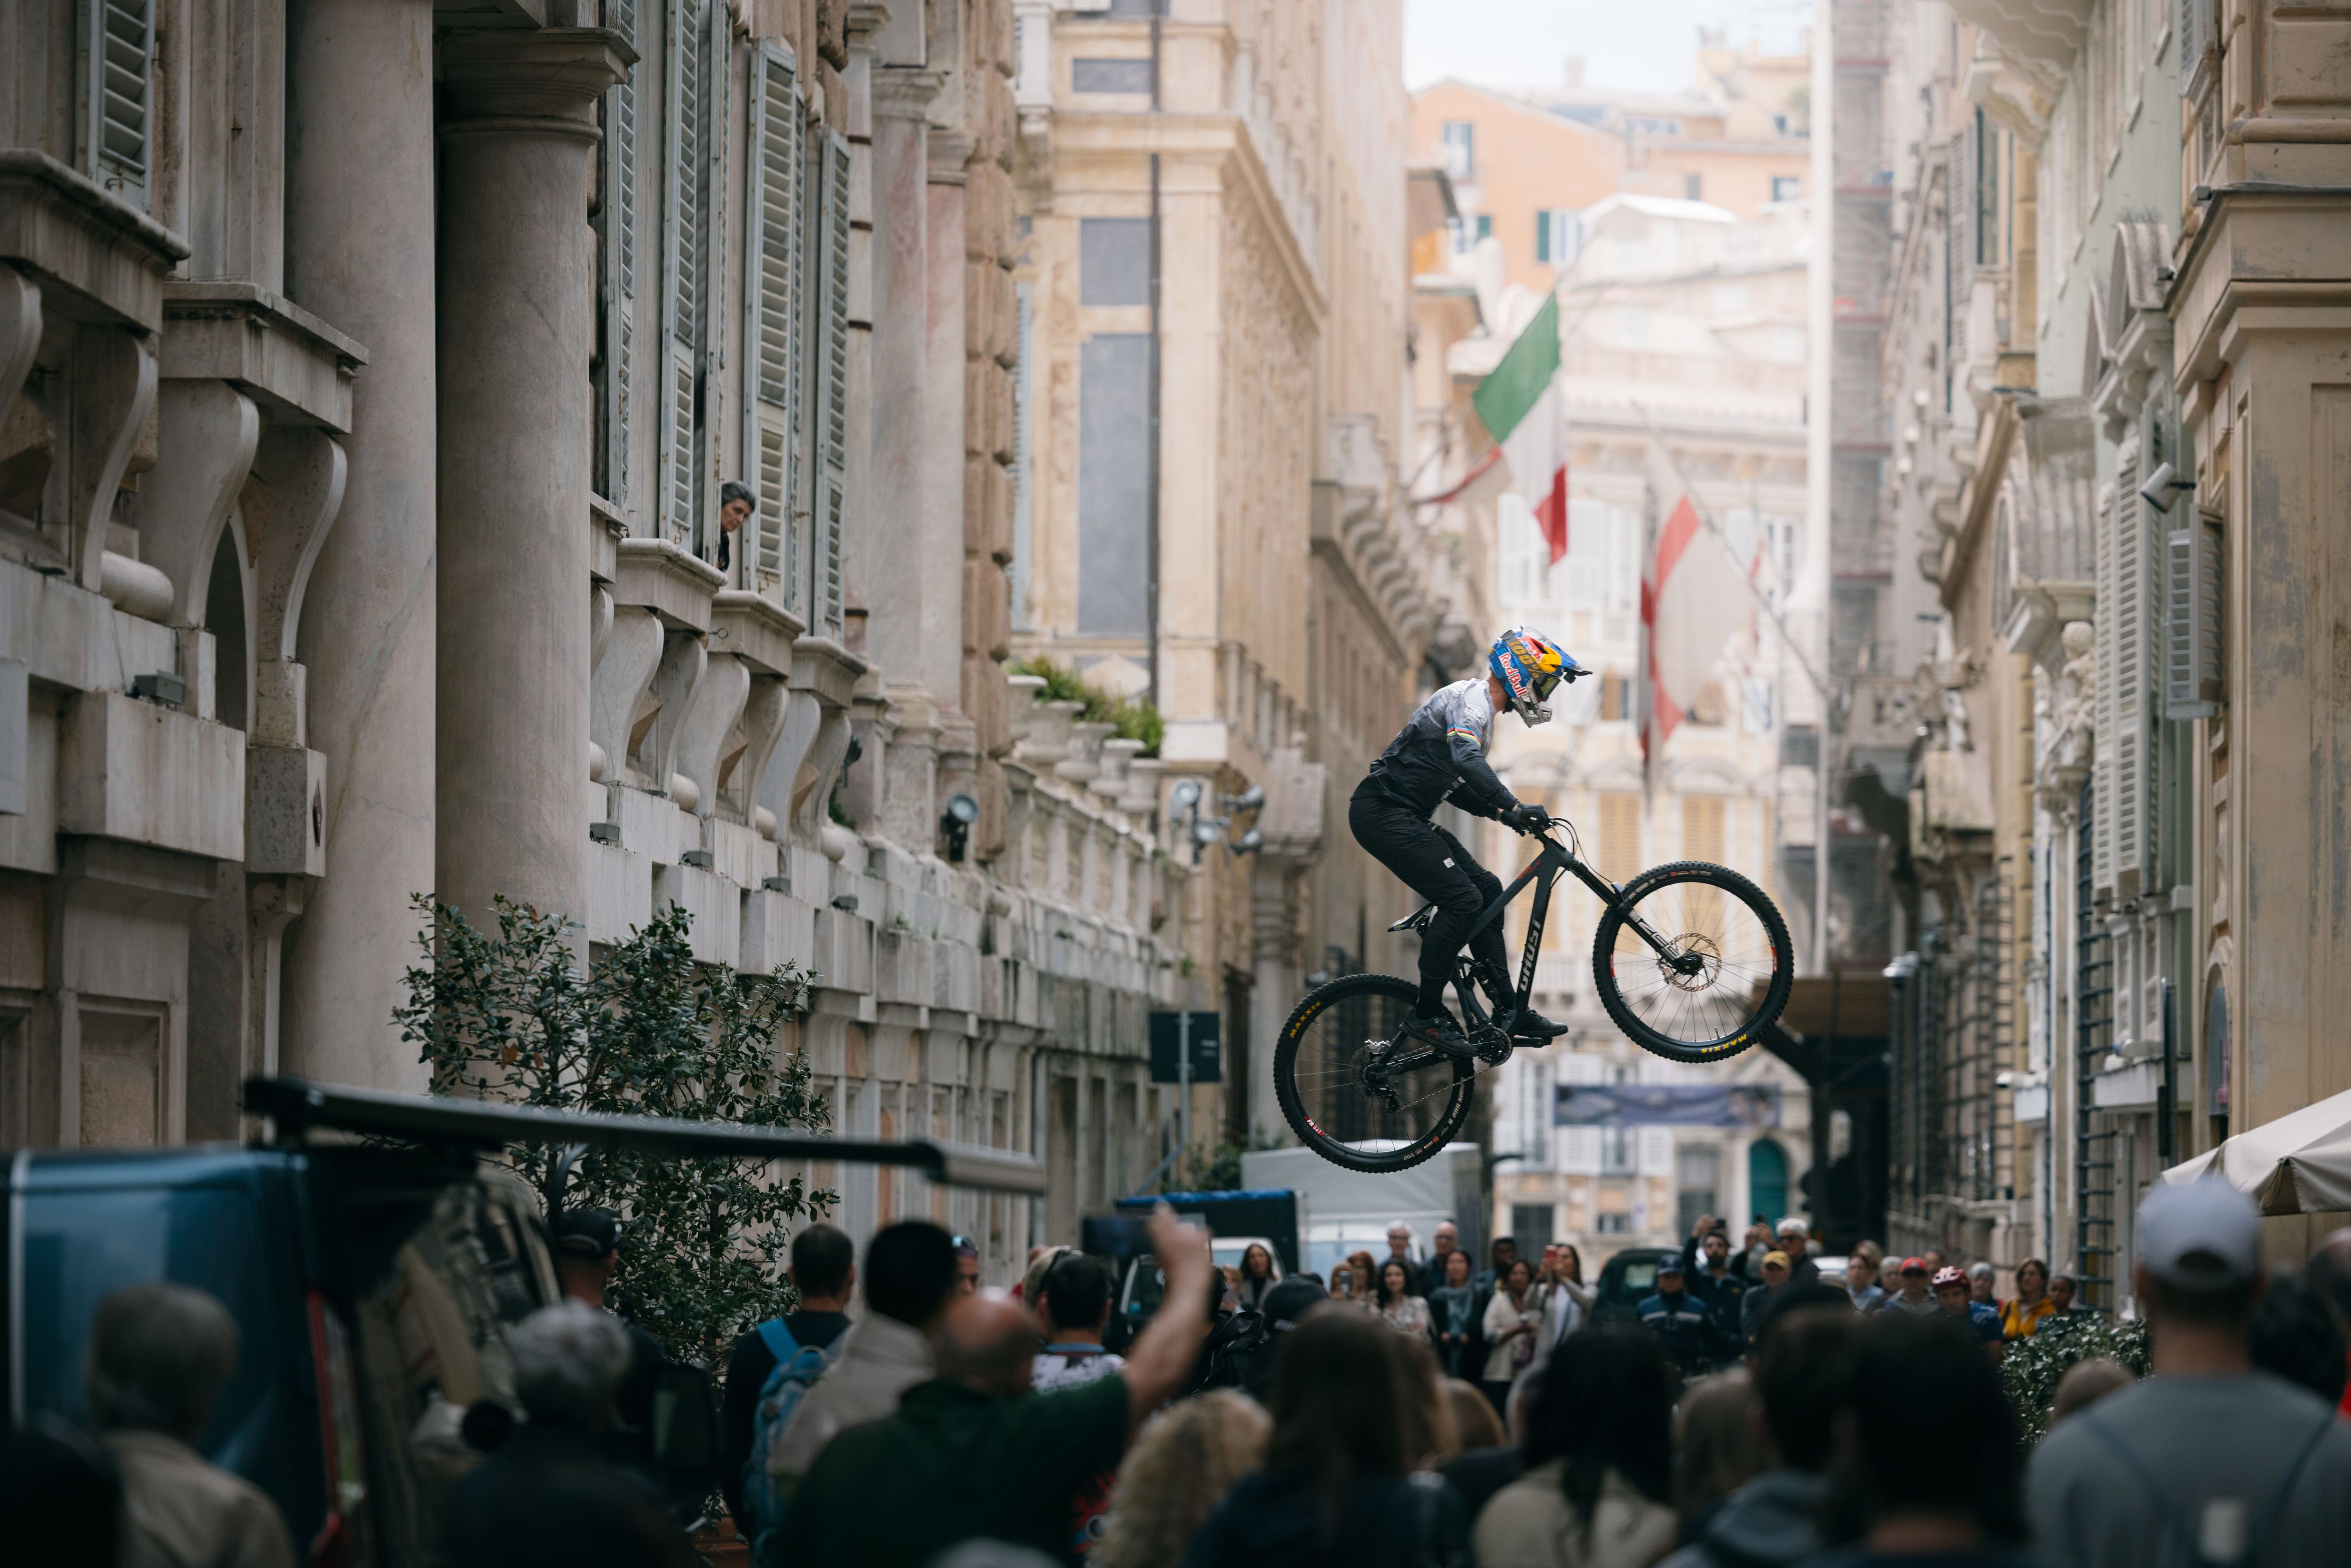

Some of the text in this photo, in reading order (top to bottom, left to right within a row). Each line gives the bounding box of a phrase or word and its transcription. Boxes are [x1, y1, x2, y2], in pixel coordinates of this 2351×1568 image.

[1499, 652, 1528, 698] Red Bull
[1508, 639, 1544, 678] 100%
[1289, 1001, 1322, 1039] MAXXIS
[1701, 1033, 1747, 1053] MAXXIS
